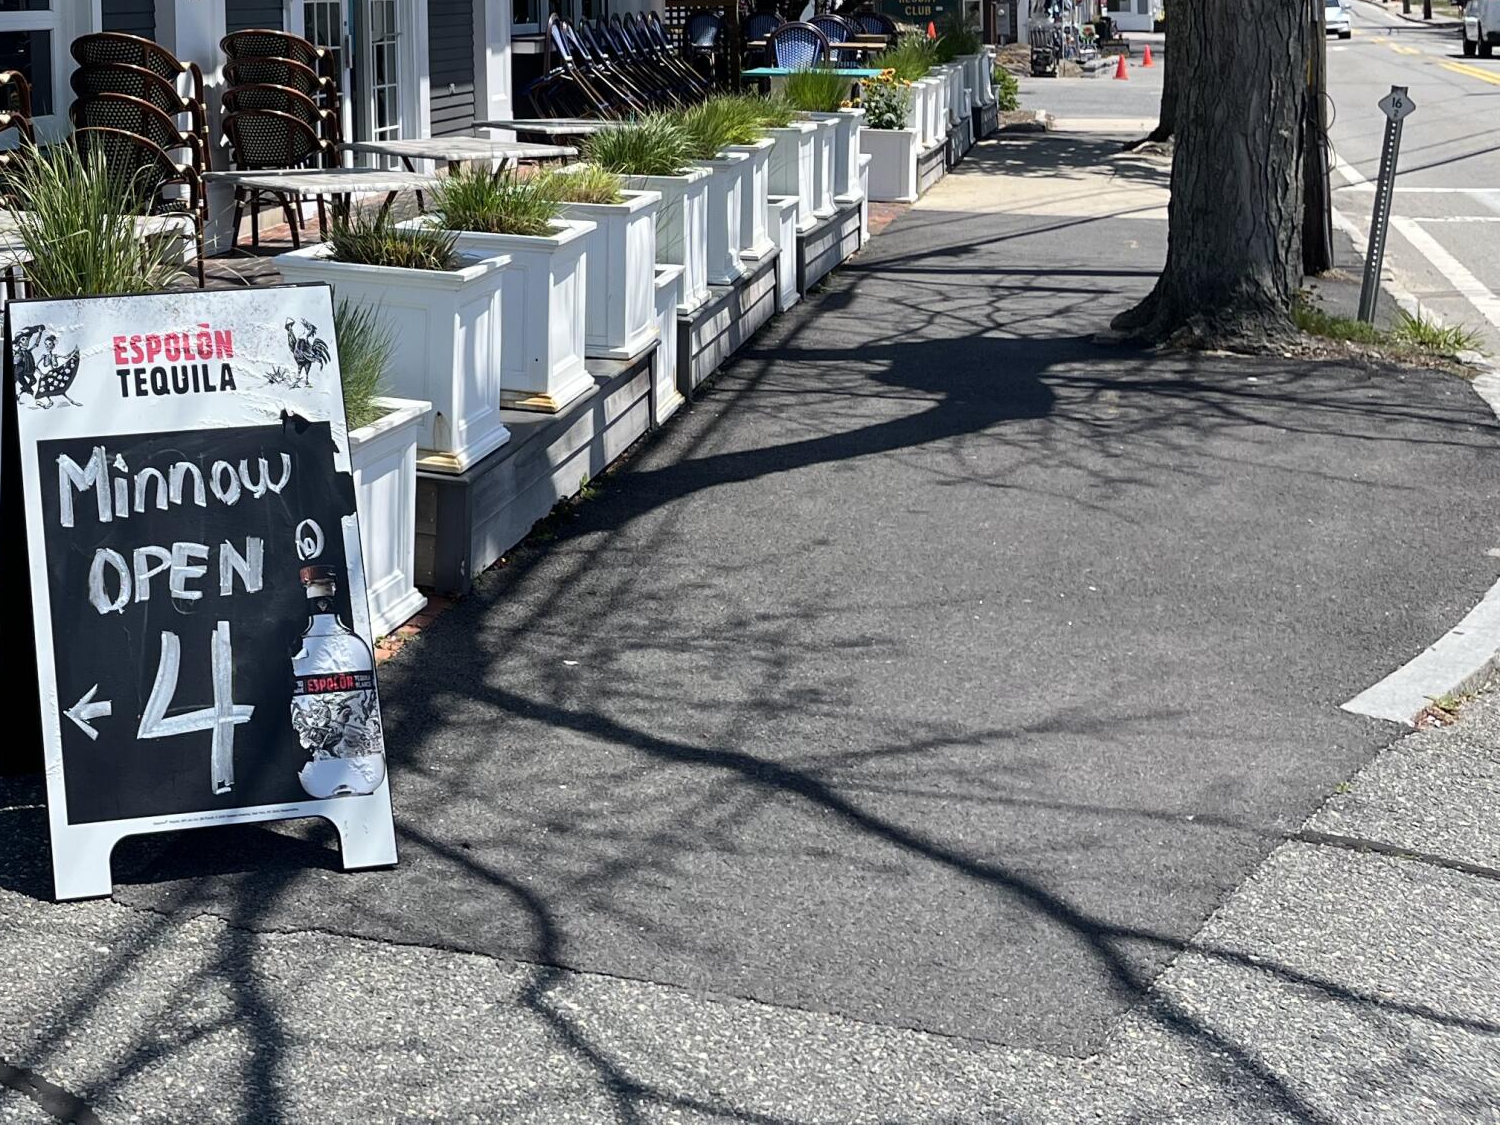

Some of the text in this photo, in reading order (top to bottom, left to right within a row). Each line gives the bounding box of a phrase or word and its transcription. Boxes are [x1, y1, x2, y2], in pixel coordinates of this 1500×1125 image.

[905, 6, 931, 16] CLUB
[1392, 97, 1402, 108] 16
[116, 363, 237, 398] TEQUILA
[56, 446, 291, 528] Minnow
[88, 536, 264, 614] OPEN
[137, 621, 255, 794] 4
